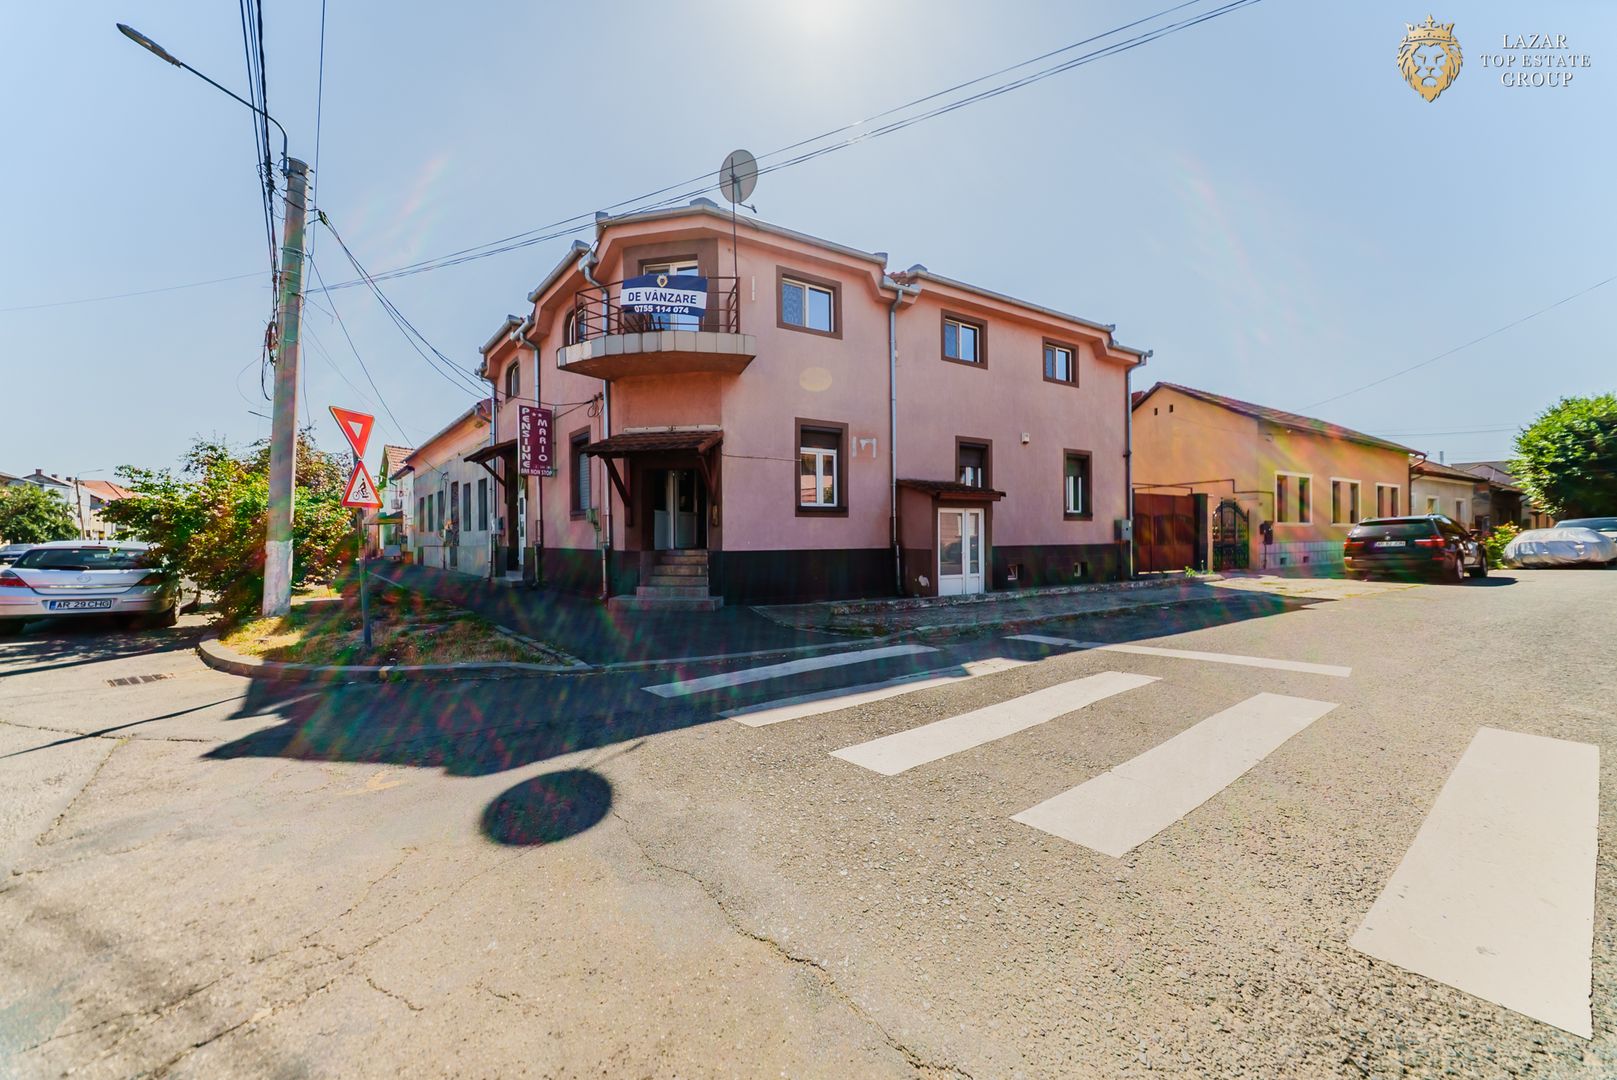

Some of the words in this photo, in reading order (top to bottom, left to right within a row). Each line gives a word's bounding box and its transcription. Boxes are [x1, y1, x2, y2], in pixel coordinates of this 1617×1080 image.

[628, 291, 641, 302] DE
[644, 290, 697, 304] VÂNZARE
[634, 305, 653, 313] 0755
[673, 306, 689, 314] 074
[521, 408, 531, 468] PENSIUNE
[537, 419, 548, 462] MARIO
